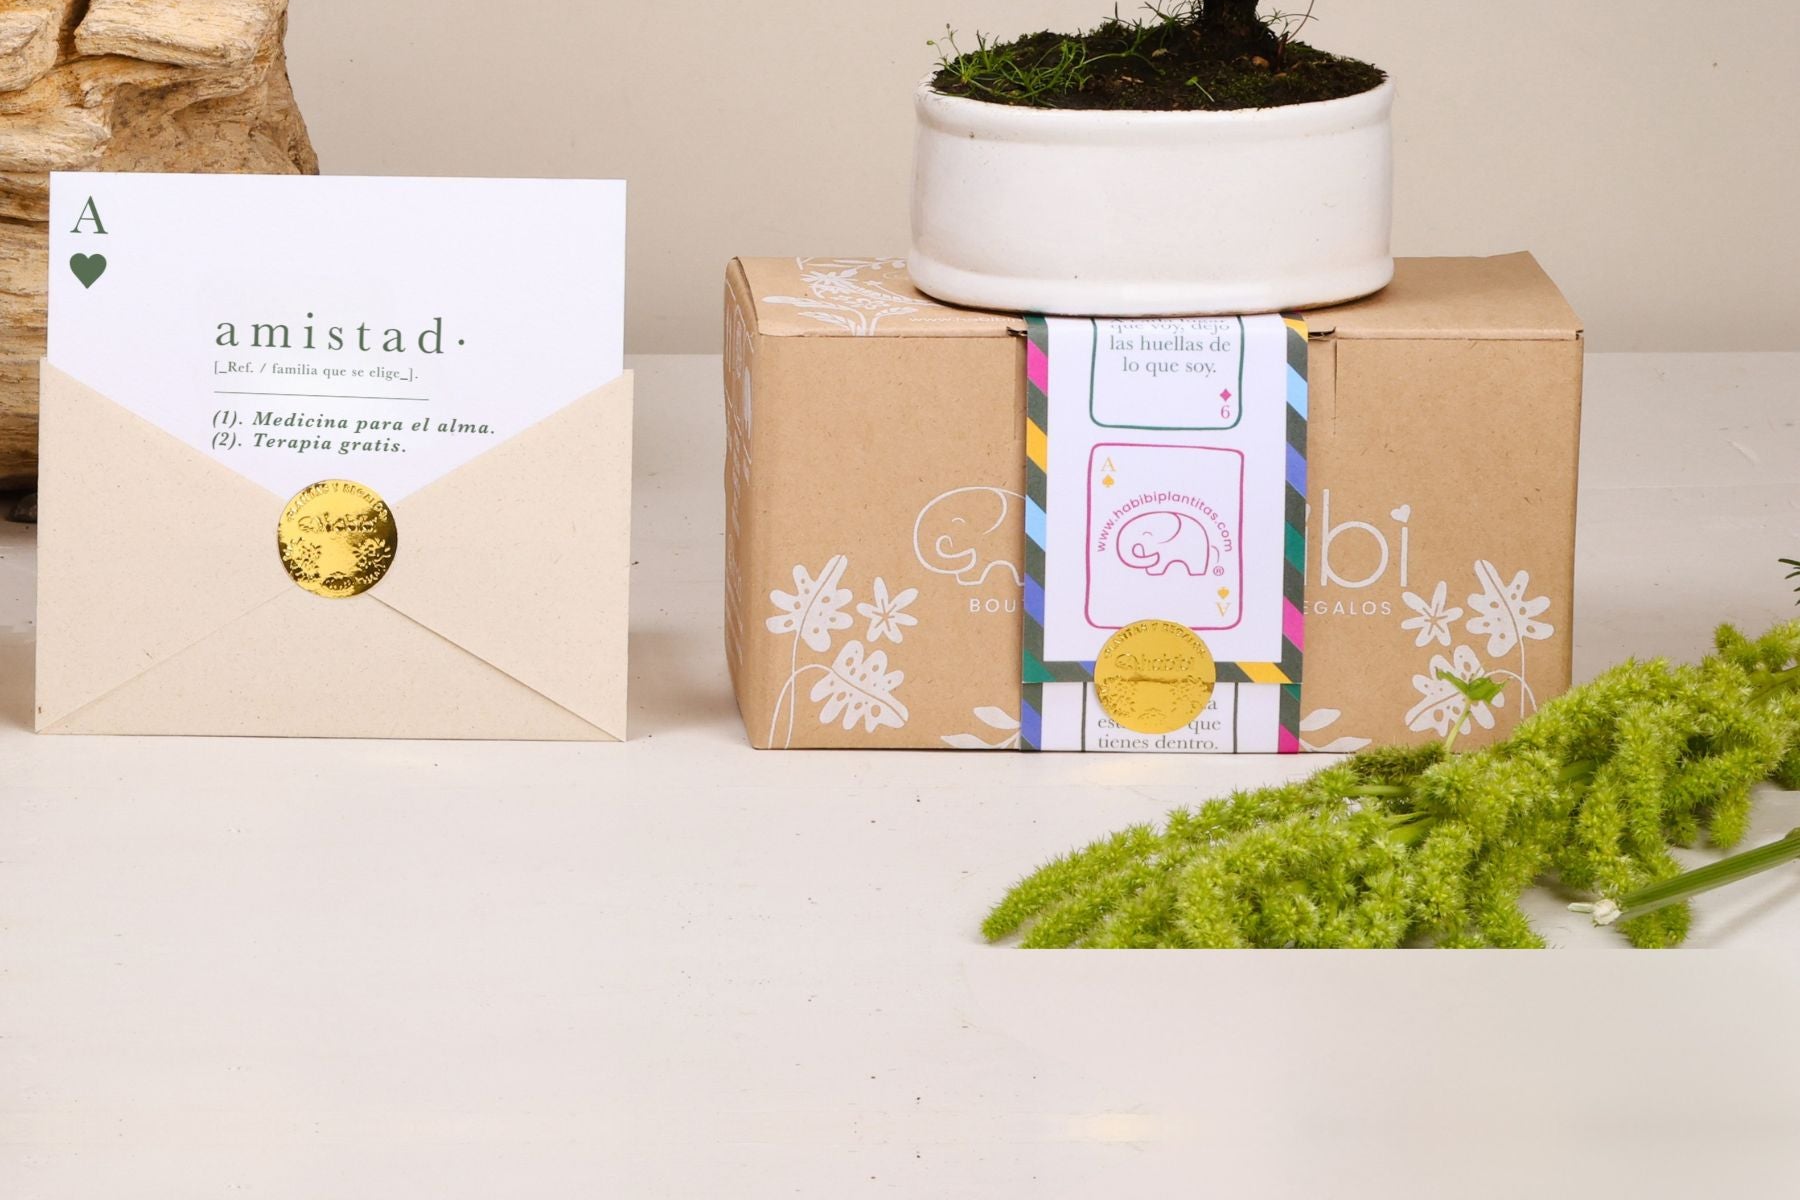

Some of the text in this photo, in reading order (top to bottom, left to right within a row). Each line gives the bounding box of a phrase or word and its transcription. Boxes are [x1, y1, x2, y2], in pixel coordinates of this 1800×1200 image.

[69, 195, 109, 234] A
[1110, 335, 1231, 352] las huellas de
[272, 362, 318, 376] familia
[323, 367, 347, 379] que
[351, 368, 365, 377] se
[1123, 356, 1216, 378] lo que soy.
[212, 410, 495, 435] (1). Medicina para el alma.
[211, 432, 407, 455] (2). Terapia gratis.
[1101, 457, 1116, 472] A
[1097, 491, 1233, 552] www.habibiplantitas.com
[970, 598, 1020, 613] BOU
[1216, 603, 1230, 617] A
[1188, 720, 1221, 735] que
[1098, 733, 1218, 750] tienes dentro.
